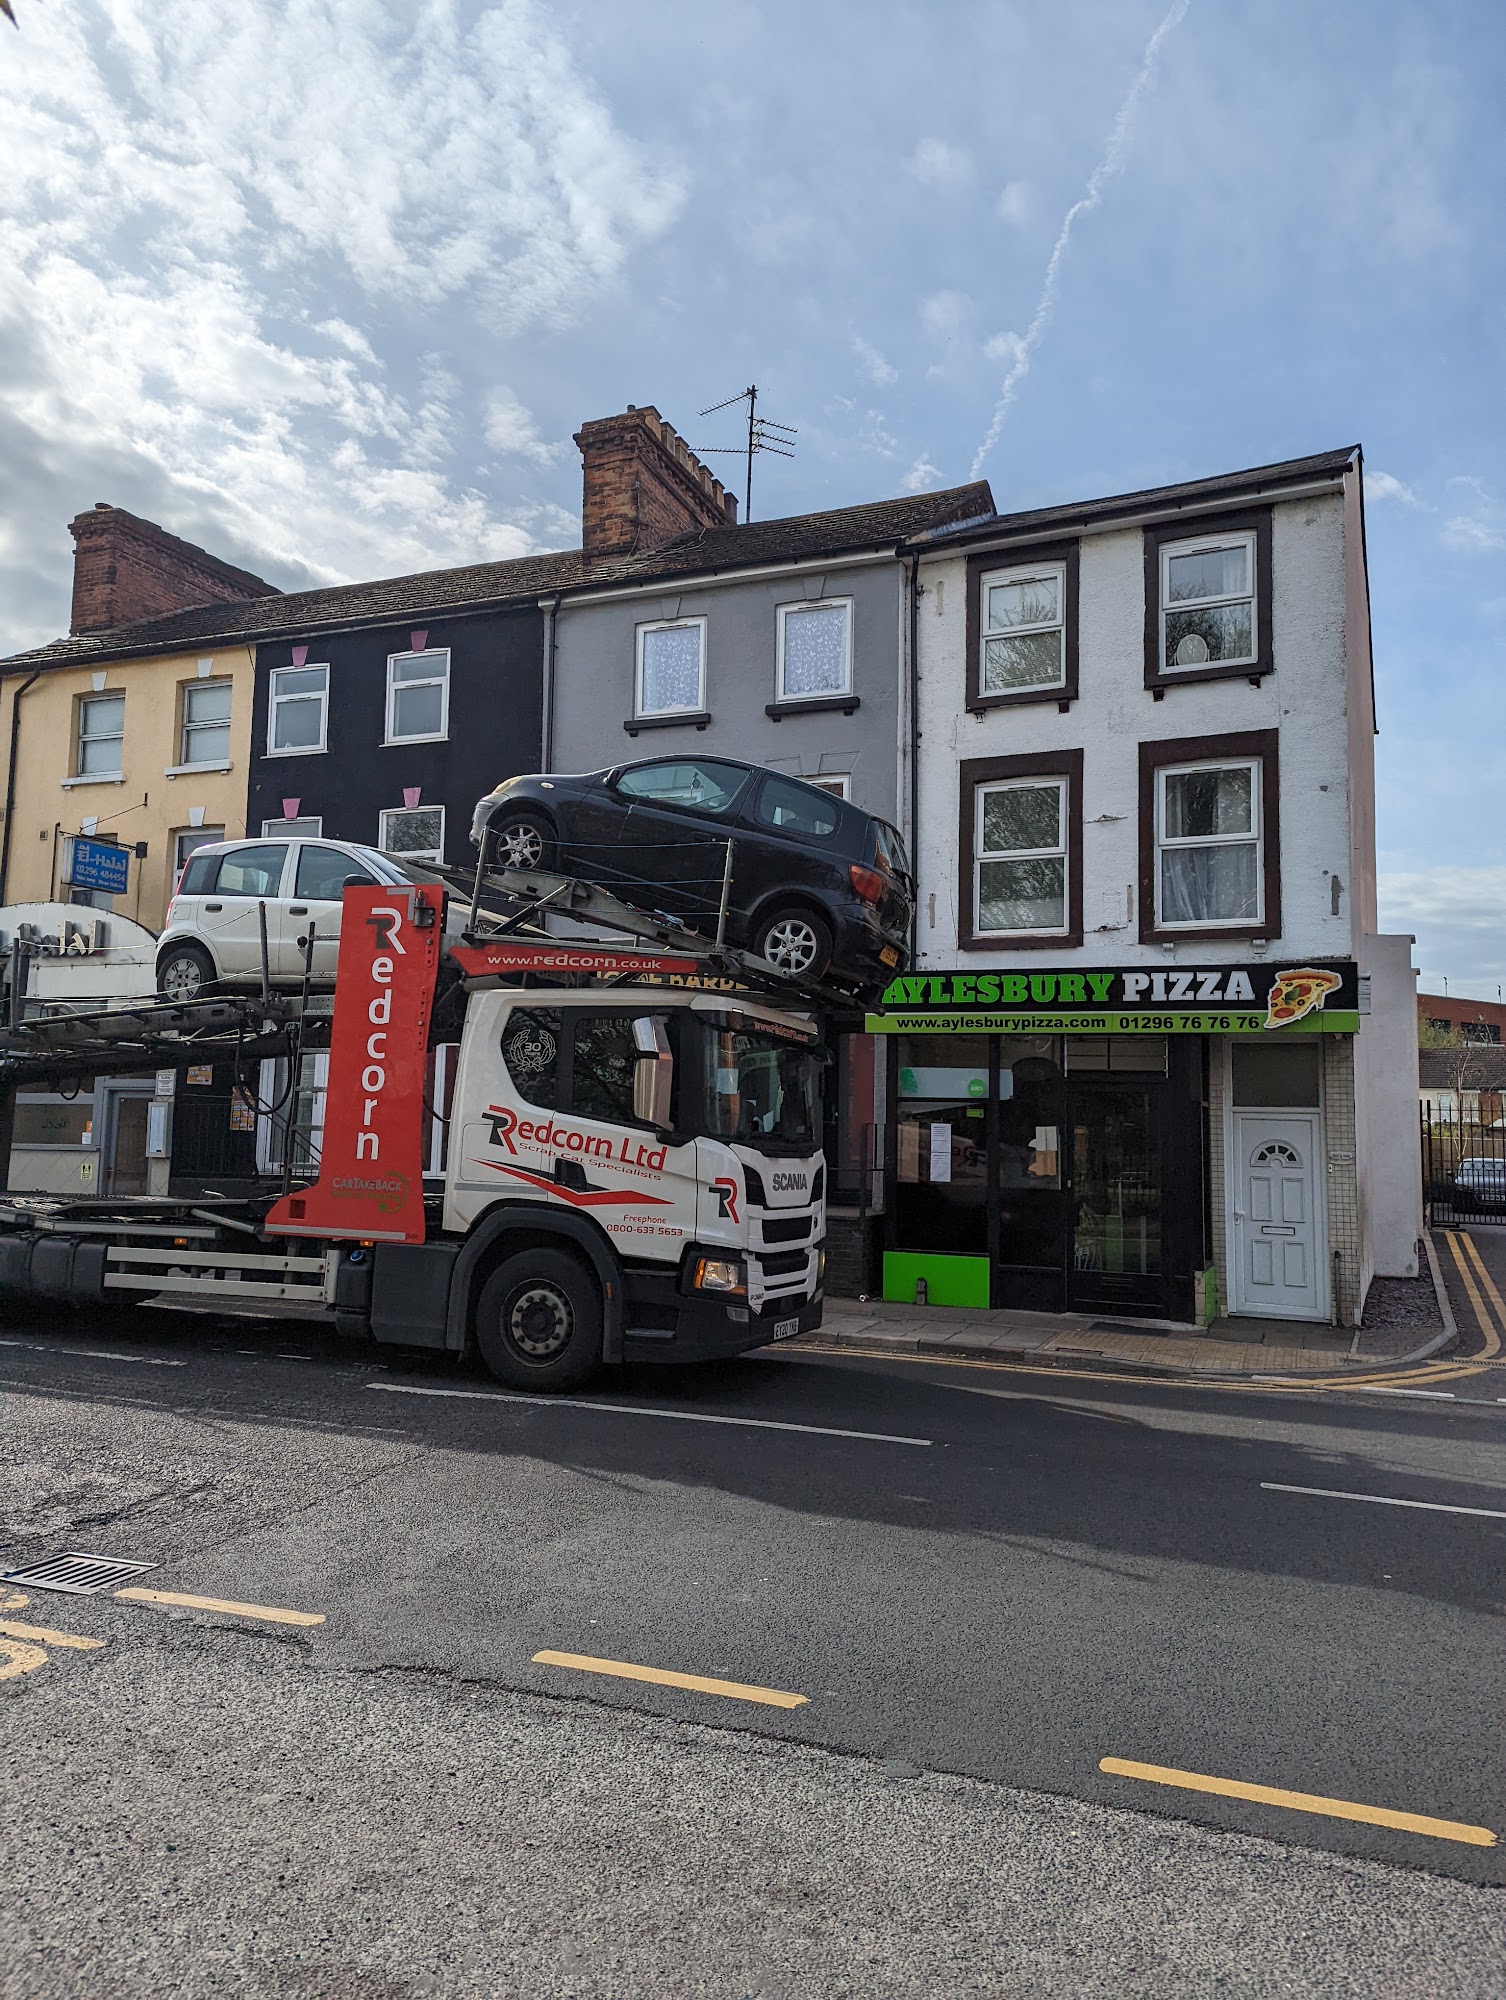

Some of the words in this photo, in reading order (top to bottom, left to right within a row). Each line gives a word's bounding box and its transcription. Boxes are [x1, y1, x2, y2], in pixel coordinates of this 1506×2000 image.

[487, 953, 661, 969] www.redcorn.co.uk
[881, 973, 1115, 1004] AYLESBURY
[1122, 970, 1256, 1001] PIZZA
[897, 1016, 1106, 1030] www.aylesburypizza.com
[1119, 1016, 1174, 1029] 01296
[1179, 1016, 1202, 1029] 76
[1207, 1016, 1231, 1029] 76
[1236, 1016, 1259, 1029] 76
[356, 907, 406, 1160] Redcorn
[524, 1042, 541, 1051] 30
[481, 1104, 613, 1159] Redcorn
[620, 1138, 668, 1171] Ltd
[519, 1142, 556, 1157] Scrap
[560, 1152, 585, 1164] Car
[588, 1158, 662, 1181] Specialists
[772, 1173, 808, 1191] SCANIA
[623, 1214, 667, 1225] Freephone
[606, 1224, 655, 1235] 0800-633
[658, 1227, 683, 1236] 5653
